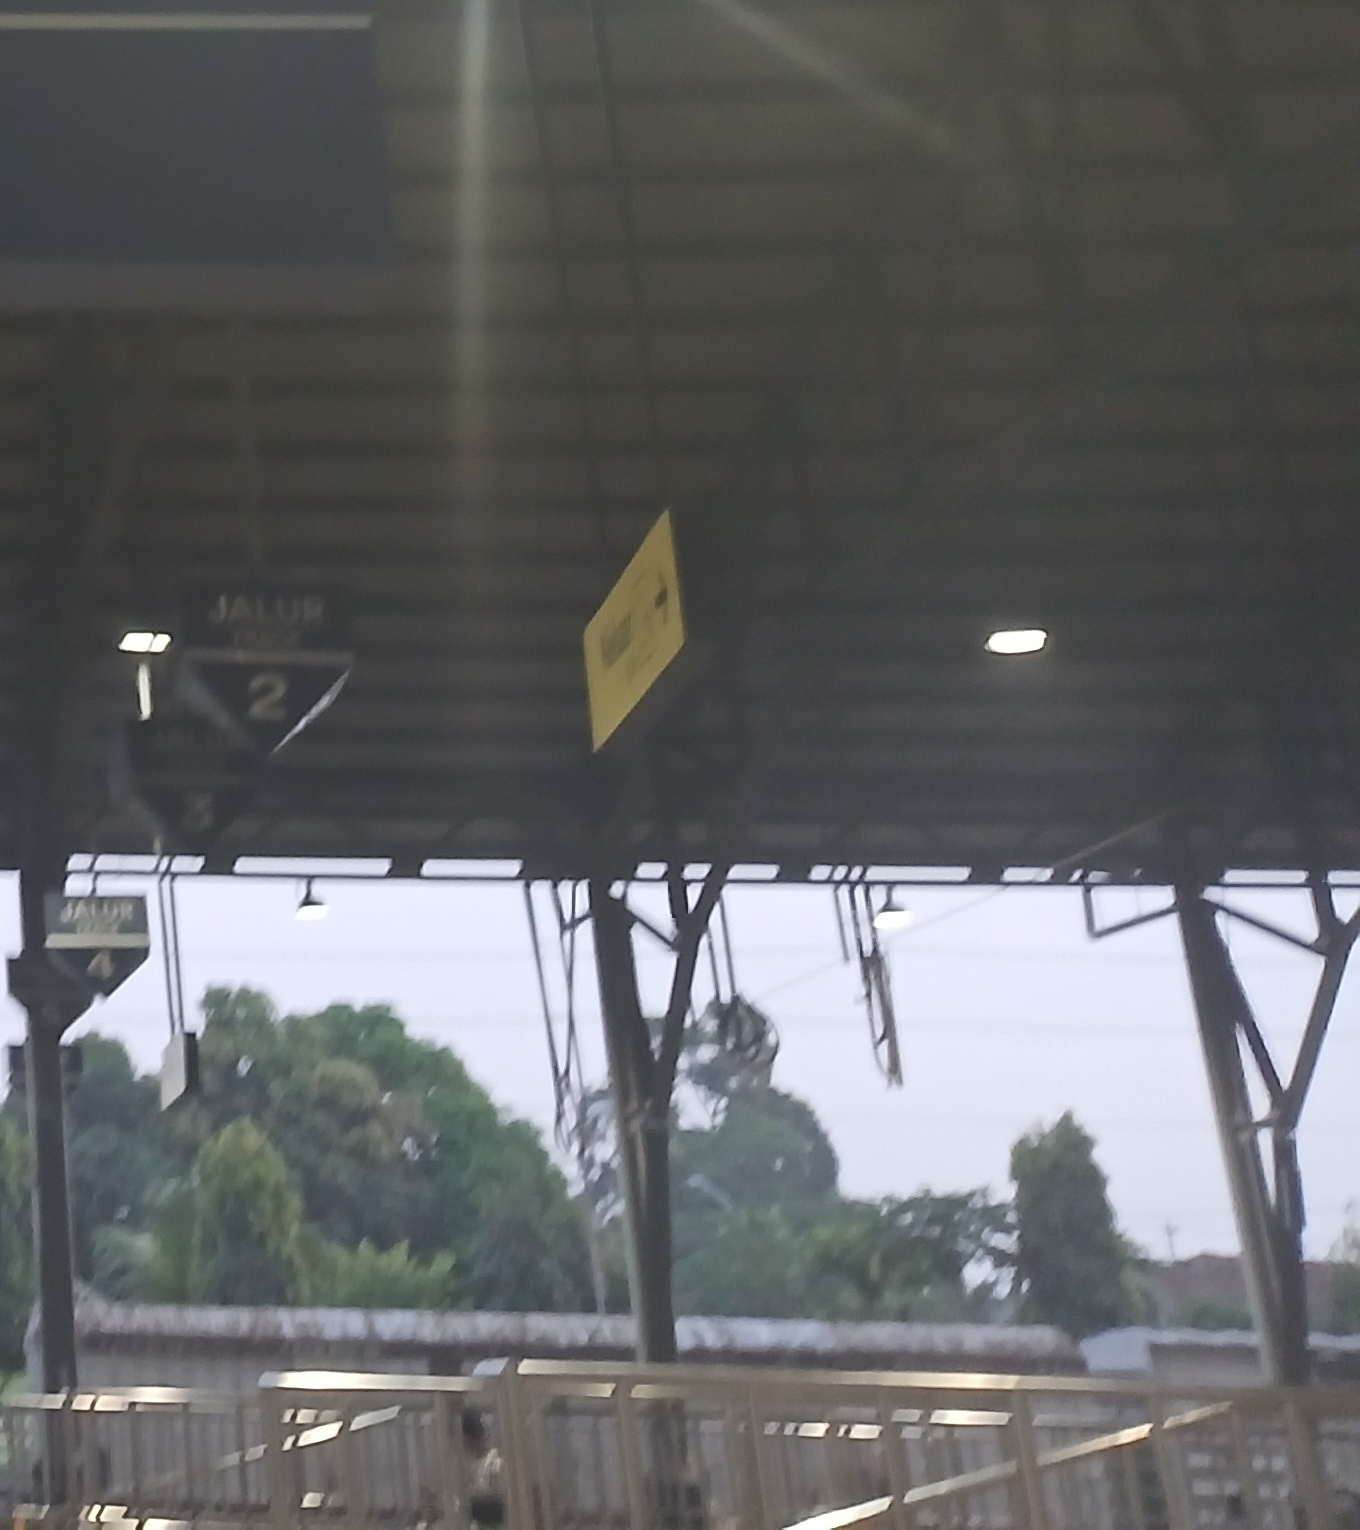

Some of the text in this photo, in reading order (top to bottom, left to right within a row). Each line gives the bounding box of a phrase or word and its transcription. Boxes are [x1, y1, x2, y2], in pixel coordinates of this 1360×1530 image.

[209, 593, 326, 626] JALUR
[248, 672, 288, 722] 2
[86, 950, 117, 980] 4
